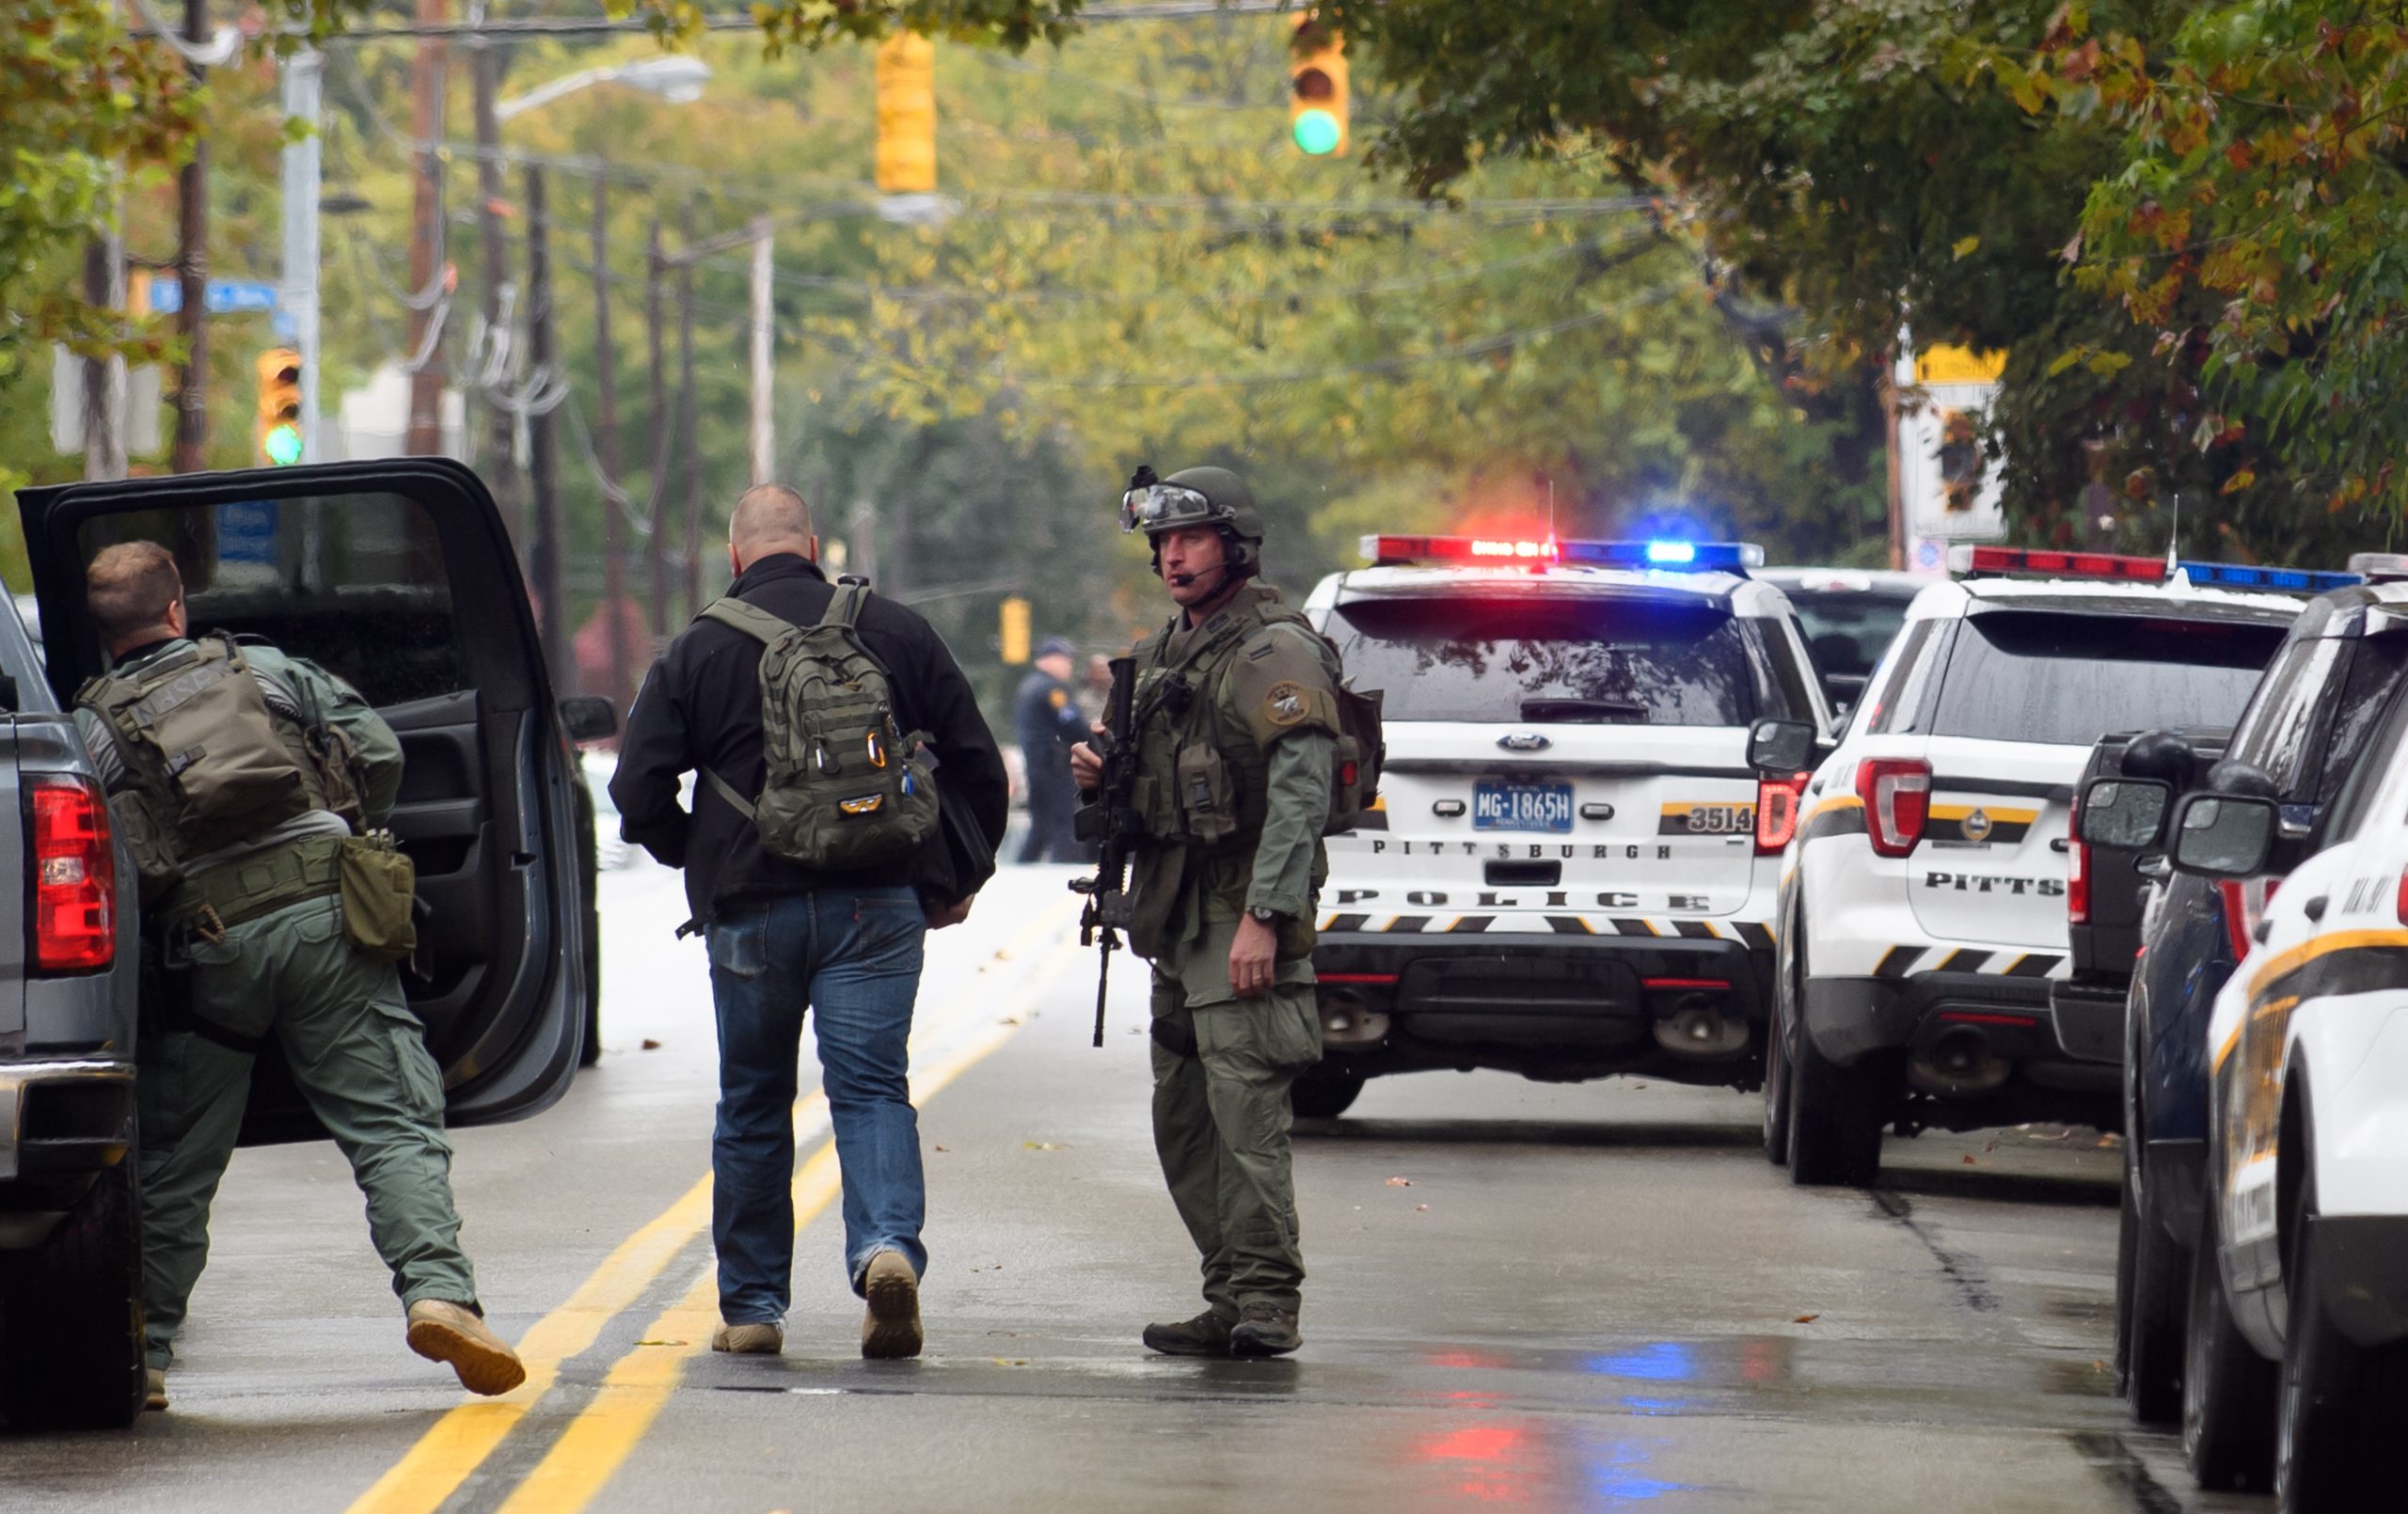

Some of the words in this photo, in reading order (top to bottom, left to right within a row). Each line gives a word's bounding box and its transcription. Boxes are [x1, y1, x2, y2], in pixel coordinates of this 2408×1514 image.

[1687, 806, 1753, 832] 3514
[1373, 840, 1671, 860] PITTSBURGH
[1337, 890, 1710, 911] POLICE
